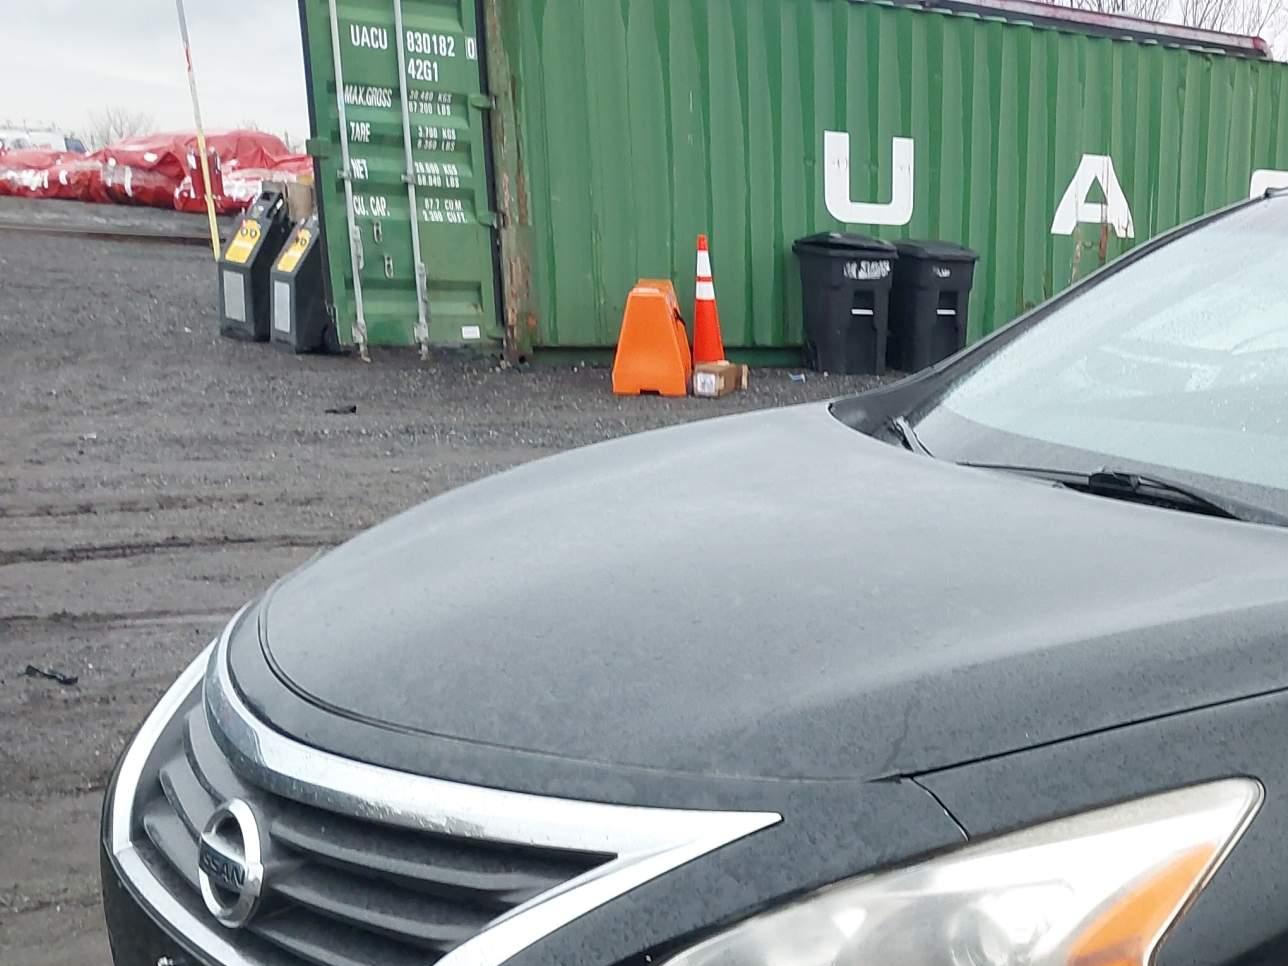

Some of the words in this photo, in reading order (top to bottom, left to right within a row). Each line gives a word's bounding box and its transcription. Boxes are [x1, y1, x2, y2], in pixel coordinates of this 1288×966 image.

[350, 24, 388, 50] UACU
[406, 31, 456, 57] 830182
[407, 58, 439, 82] 42G1
[350, 121, 371, 142] TARE
[351, 157, 369, 180] NET
[370, 196, 391, 217] CAP.
